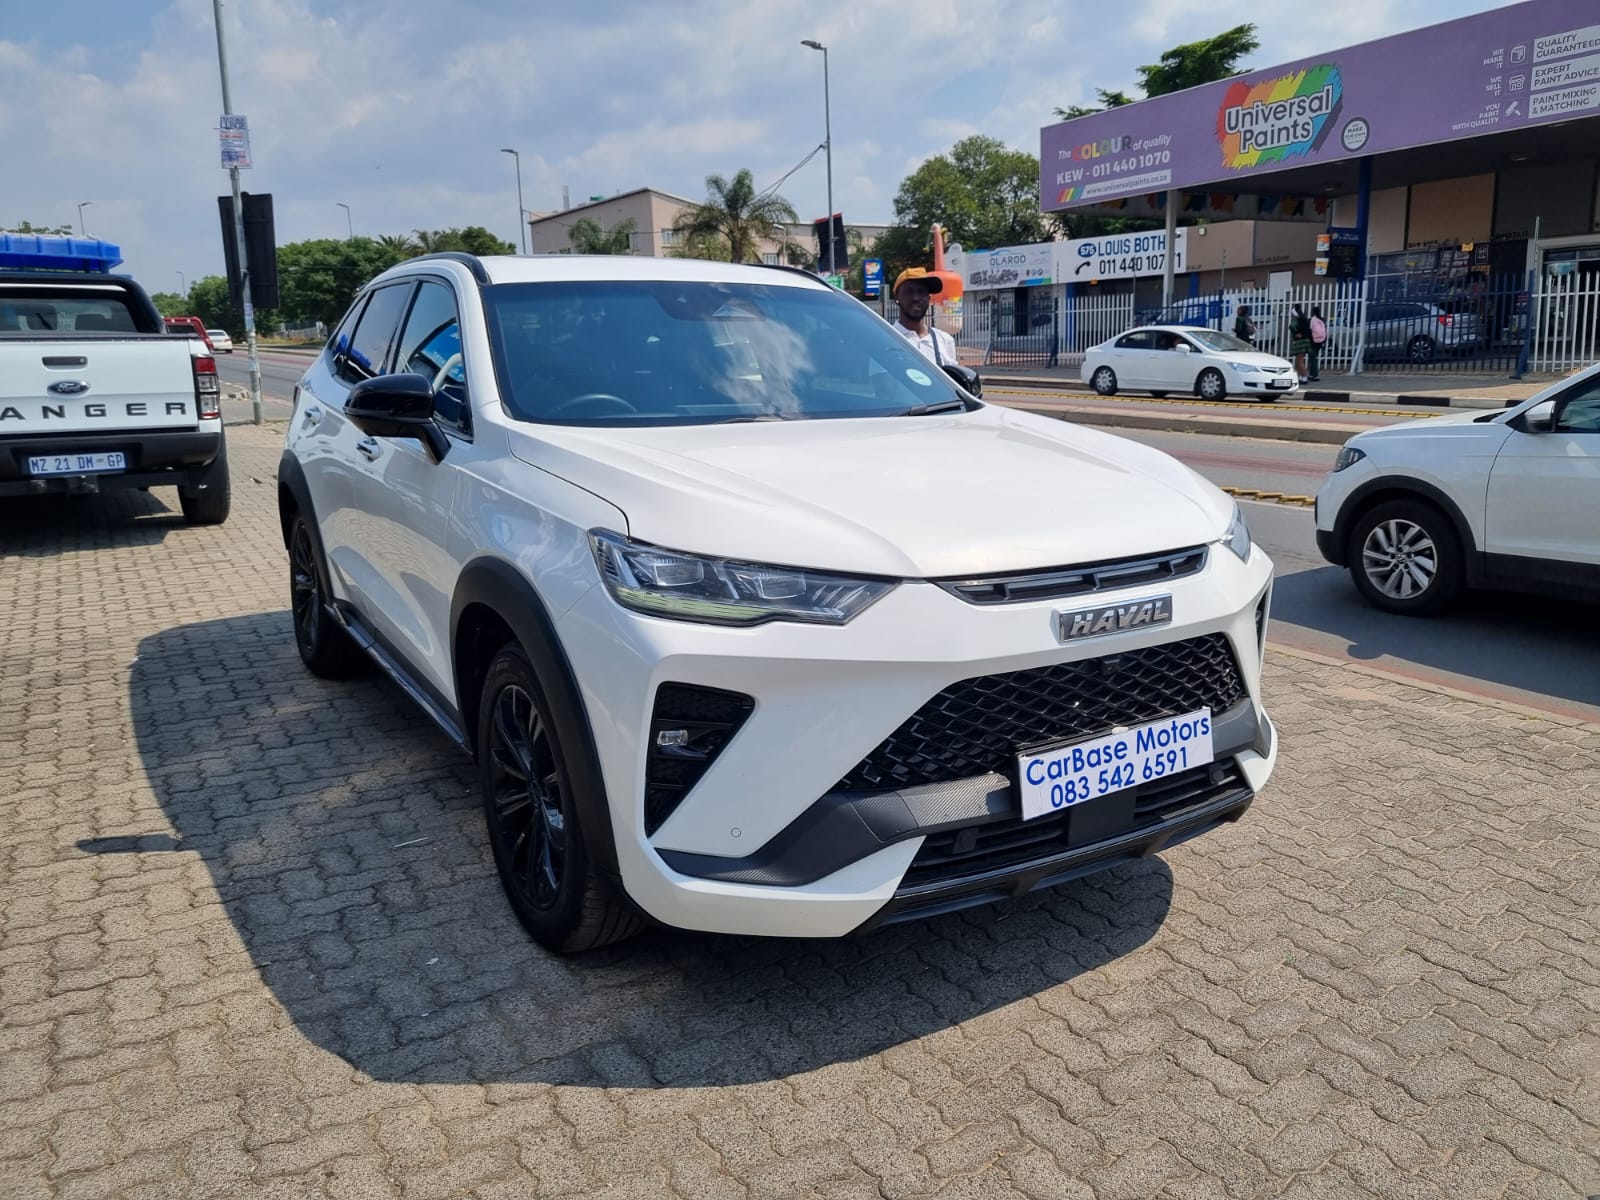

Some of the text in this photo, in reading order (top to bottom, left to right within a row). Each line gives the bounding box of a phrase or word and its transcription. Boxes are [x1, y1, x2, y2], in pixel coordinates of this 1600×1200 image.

[1536, 34, 1577, 49] QUALITY
[1536, 39, 1600, 58] GUARANTEED
[1492, 48, 1504, 56] WE
[1534, 67, 1599, 87] PAINT ADVICE
[1535, 64, 1571, 77] EXPERT
[1533, 87, 1597, 106] PAINT MIXING
[1540, 98, 1590, 113] MATCHING
[1226, 87, 1331, 131] Universal
[1479, 110, 1500, 119] PAINT
[1485, 103, 1500, 111] YOU
[1452, 116, 1499, 130] WITH QUALITY
[1242, 119, 1311, 152] Paints
[1058, 135, 1171, 162] The COLOUR of quality
[1056, 167, 1083, 184] KEW
[1092, 162, 1110, 177] 011
[1113, 158, 1137, 173] 440
[1139, 150, 1170, 169] 1070
[1098, 238, 1130, 256] LOUIS
[1134, 234, 1165, 253] BOTH
[1100, 259, 1115, 274] 011
[1119, 257, 1142, 272] 440
[0, 402, 187, 421] ANGER
[55, 457, 71, 471] 21
[107, 454, 123, 467] GP
[1070, 601, 1168, 635] HAVAL
[1026, 717, 1210, 786] CarBase Motors
[1050, 747, 1187, 808] 083 542 6591
